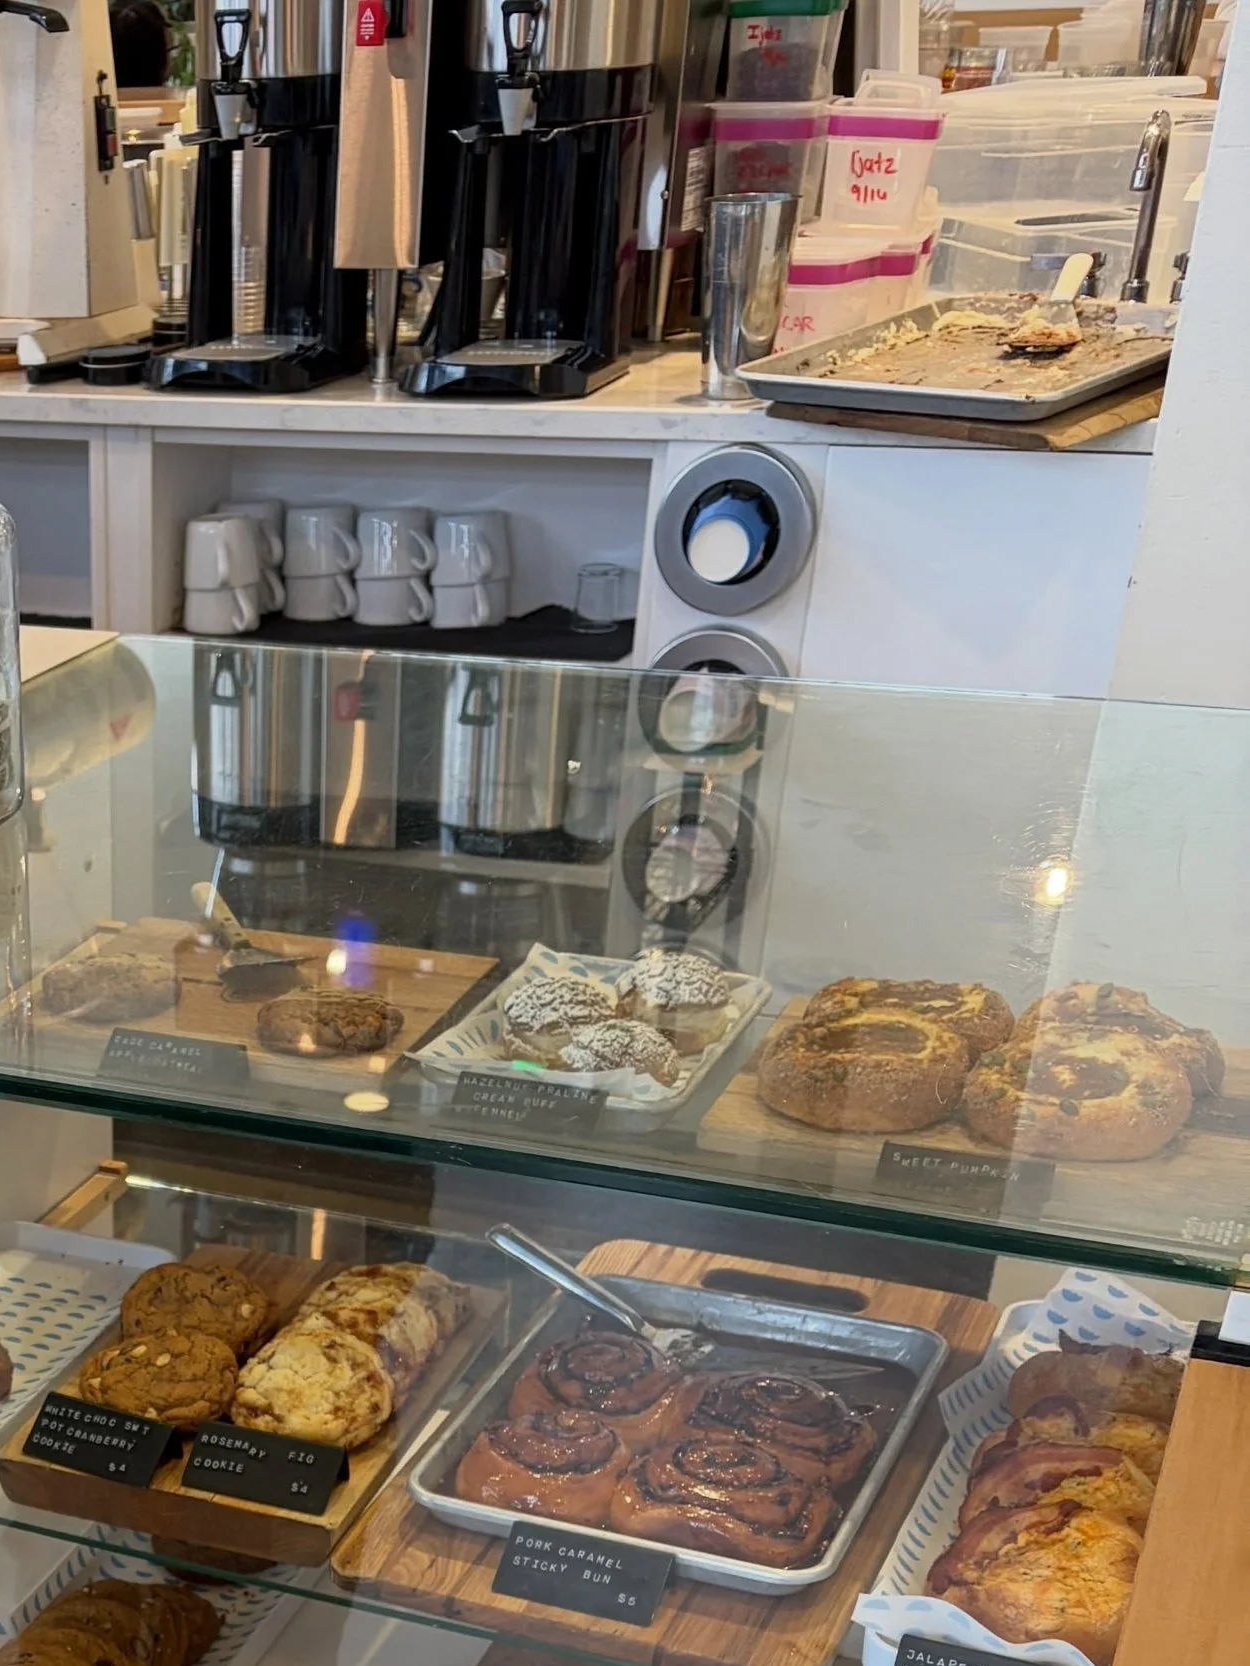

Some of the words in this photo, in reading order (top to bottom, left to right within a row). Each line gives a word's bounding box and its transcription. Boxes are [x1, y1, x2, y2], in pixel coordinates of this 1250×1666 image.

[893, 1151, 943, 1168] SWEET
[45, 1405, 82, 1420] WHITE
[84, 1414, 117, 1428] CHOC
[33, 1434, 76, 1455] COOKIE
[41, 1418, 65, 1432] POT
[67, 1427, 135, 1451] CRANBERRY
[201, 1434, 267, 1459] ROSEMARY
[288, 1451, 315, 1465] FIG
[194, 1458, 244, 1473] COOKIE
[515, 1536, 553, 1552] PORK
[558, 1547, 624, 1570] CARAMEL
[513, 1555, 568, 1574] STICKY
[583, 1570, 612, 1585] BUN
